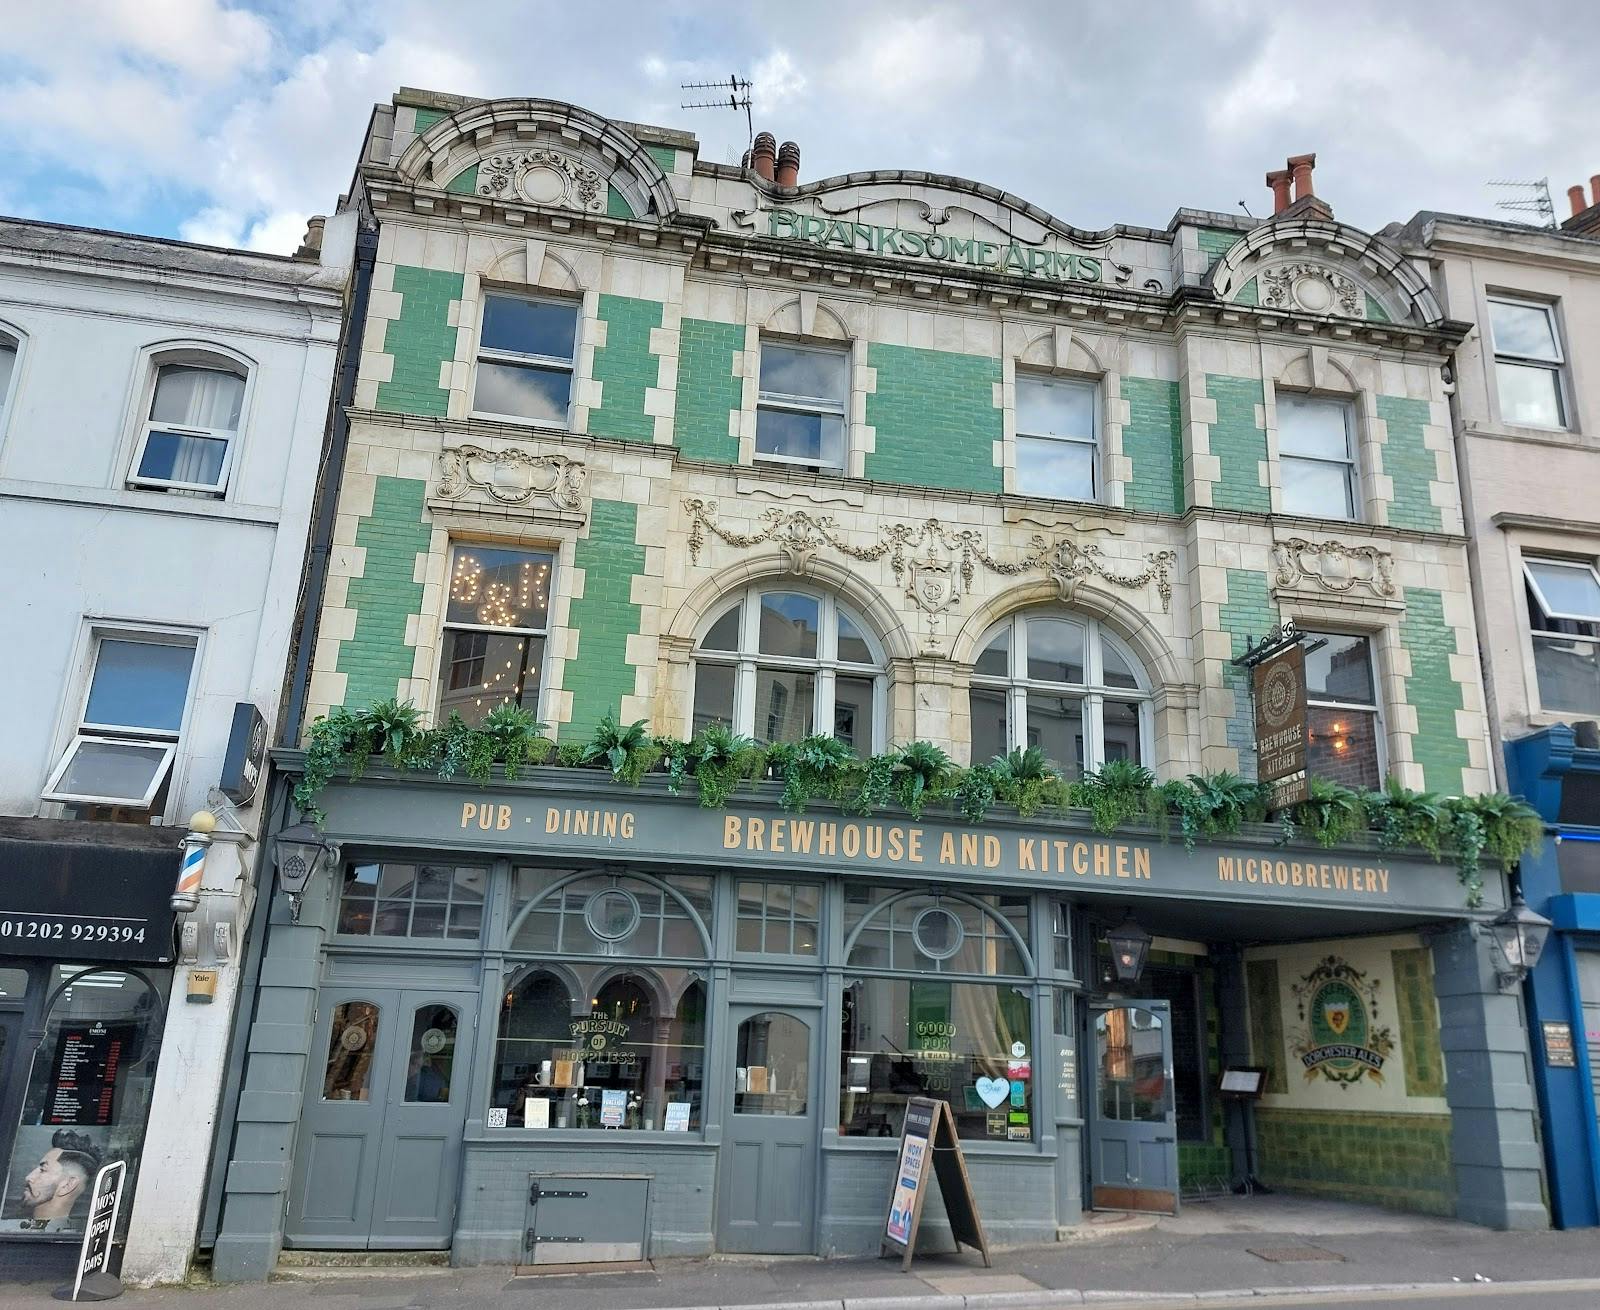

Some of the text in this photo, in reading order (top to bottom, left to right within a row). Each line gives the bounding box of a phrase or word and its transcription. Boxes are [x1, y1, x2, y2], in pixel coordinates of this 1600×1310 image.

[768, 207, 1102, 283] BRANKSOME ARMS
[1260, 723, 1302, 754] BREWHOUSE
[1267, 752, 1296, 775] KITCHEN
[460, 802, 636, 840] PUB DINING
[723, 815, 1151, 880] BREWHOUSE AND KITCHEN
[1217, 856, 1391, 893] MICROBREWERY
[1, 920, 146, 943] 01202 929394
[194, 974, 210, 982] Yale
[592, 1011, 609, 1020] THE
[568, 1019, 630, 1037] PURSUIT
[916, 1021, 957, 1037] GOOD
[593, 1038, 603, 1047] OF
[921, 1035, 950, 1050] FOR
[1304, 1046, 1381, 1068] DORCHESTER ALES
[97, 1191, 116, 1211] MO'S
[90, 1217, 111, 1238] OPEN
[94, 1238, 100, 1252] 7
[84, 1251, 104, 1273] DAYS
